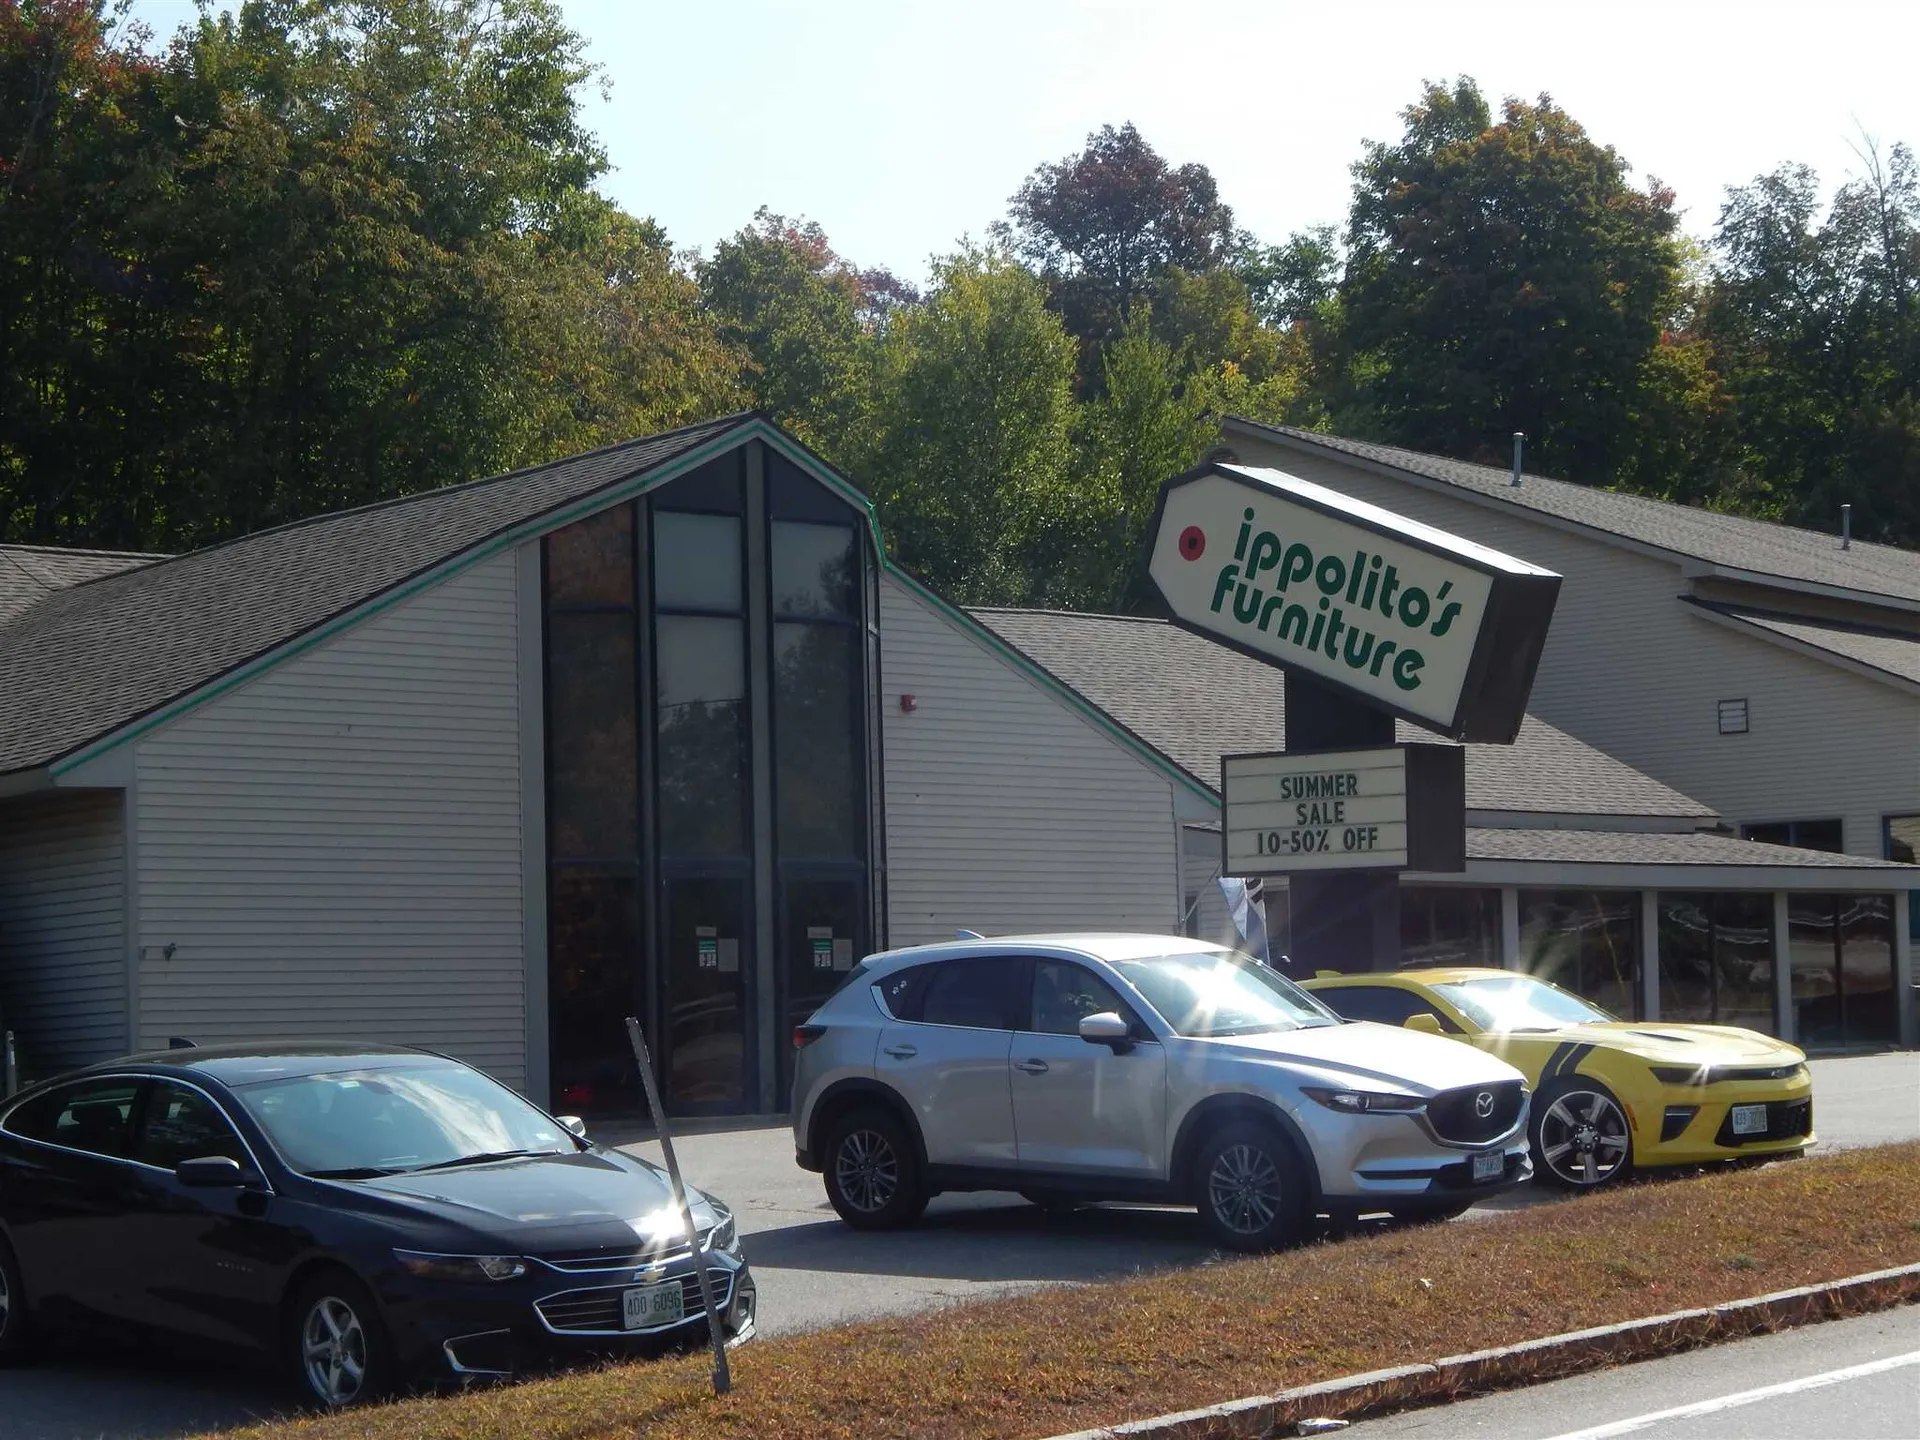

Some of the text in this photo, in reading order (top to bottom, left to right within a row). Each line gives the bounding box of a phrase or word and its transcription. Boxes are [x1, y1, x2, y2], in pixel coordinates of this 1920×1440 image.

[1234, 507, 1462, 637] ippolito's
[1210, 564, 1425, 691] furniture
[1281, 773, 1358, 799] SUMMER
[1297, 801, 1344, 825] SALE
[1257, 827, 1378, 854] 10-50% OFF
[653, 1290, 681, 1312] 6096
